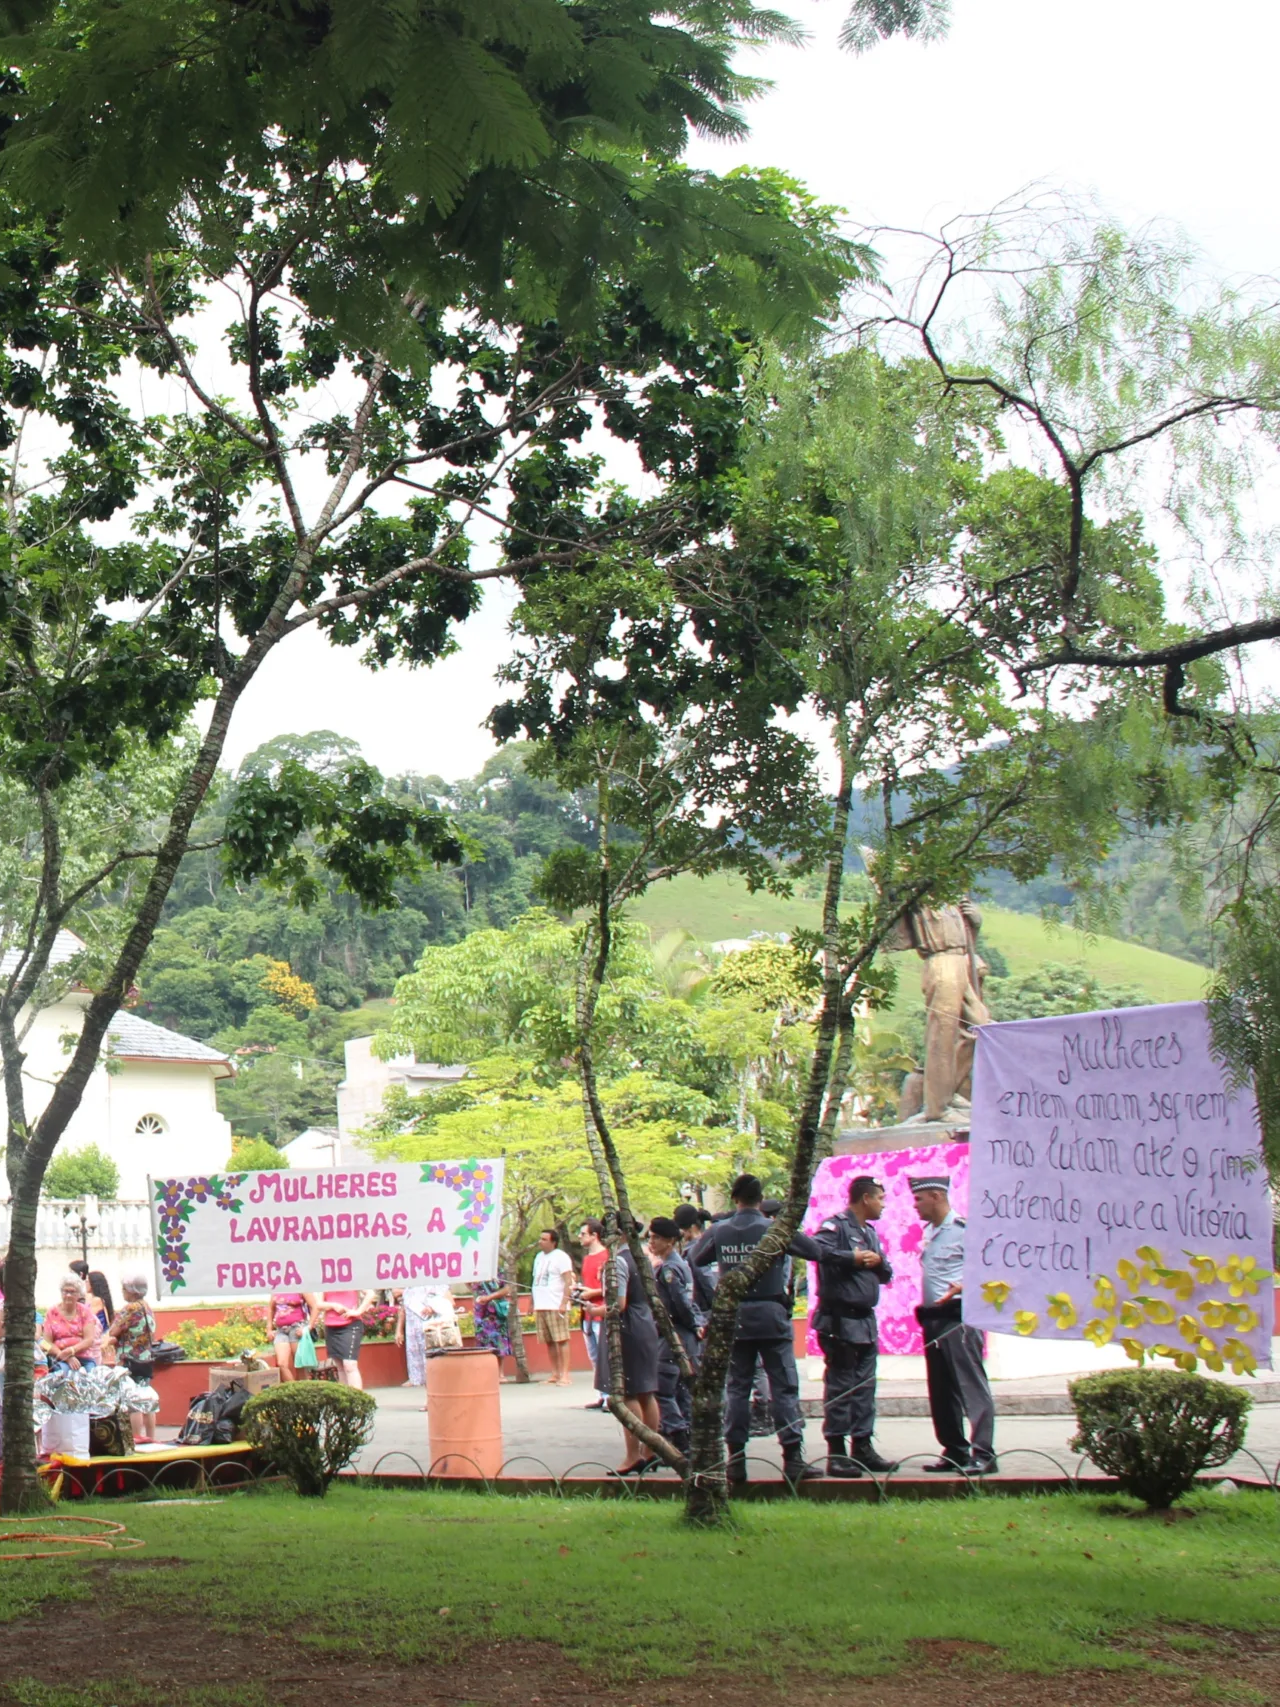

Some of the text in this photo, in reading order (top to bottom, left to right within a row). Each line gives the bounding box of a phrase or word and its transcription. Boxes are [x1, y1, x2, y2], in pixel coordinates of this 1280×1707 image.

[1058, 1016, 1183, 1085] Mulheres
[987, 1137, 1035, 1168] mas
[1046, 1126, 1122, 1175] lutam
[1133, 1136, 1176, 1179] até
[1183, 1150, 1199, 1179] o
[250, 1172, 397, 1204] MULHERES
[981, 1180, 1082, 1228] sabendo
[1151, 1200, 1168, 1230] a
[229, 1207, 446, 1243] LAVRADORAS, A
[721, 1242, 757, 1254] POLÍCI
[981, 1232, 1003, 1268] é
[216, 1260, 302, 1291] FORÇA
[320, 1257, 353, 1285] DO
